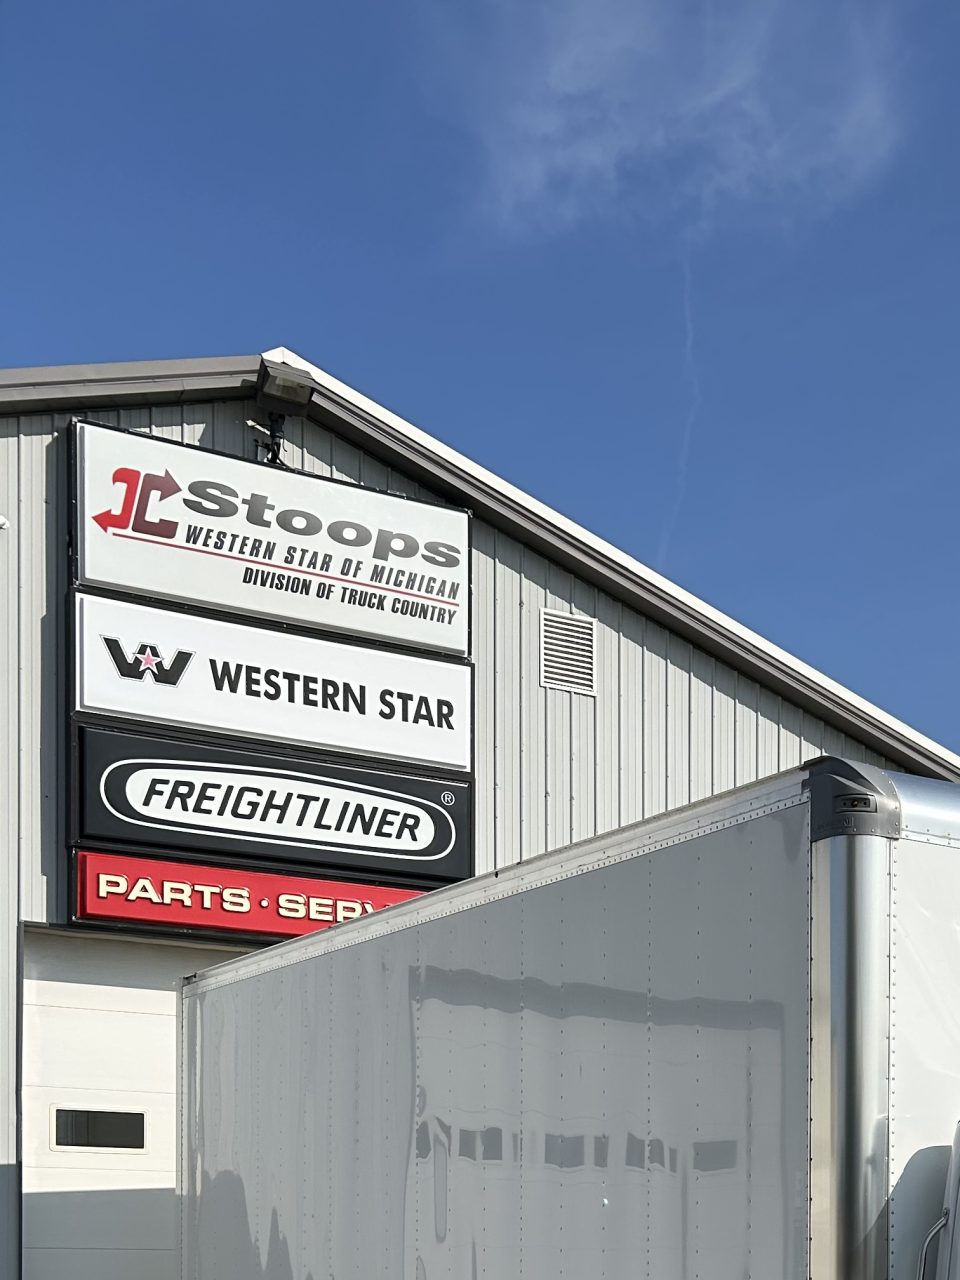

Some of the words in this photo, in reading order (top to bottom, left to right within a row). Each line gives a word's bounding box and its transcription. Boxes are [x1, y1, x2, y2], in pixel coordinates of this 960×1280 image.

[182, 479, 462, 569] Stoops
[185, 524, 277, 560] WESTERN
[284, 545, 333, 573] STAR
[340, 557, 364, 580] OF
[369, 563, 461, 601] MICHIGAN
[242, 567, 313, 596] DIVISION
[316, 581, 336, 601] OF
[340, 586, 387, 611] TRUCK
[390, 597, 458, 625] COUNTRY
[208, 658, 367, 716] WESTERN
[378, 688, 455, 731] STAR
[142, 778, 422, 842] FREIGHTLINER
[98, 873, 252, 914] PARTS
